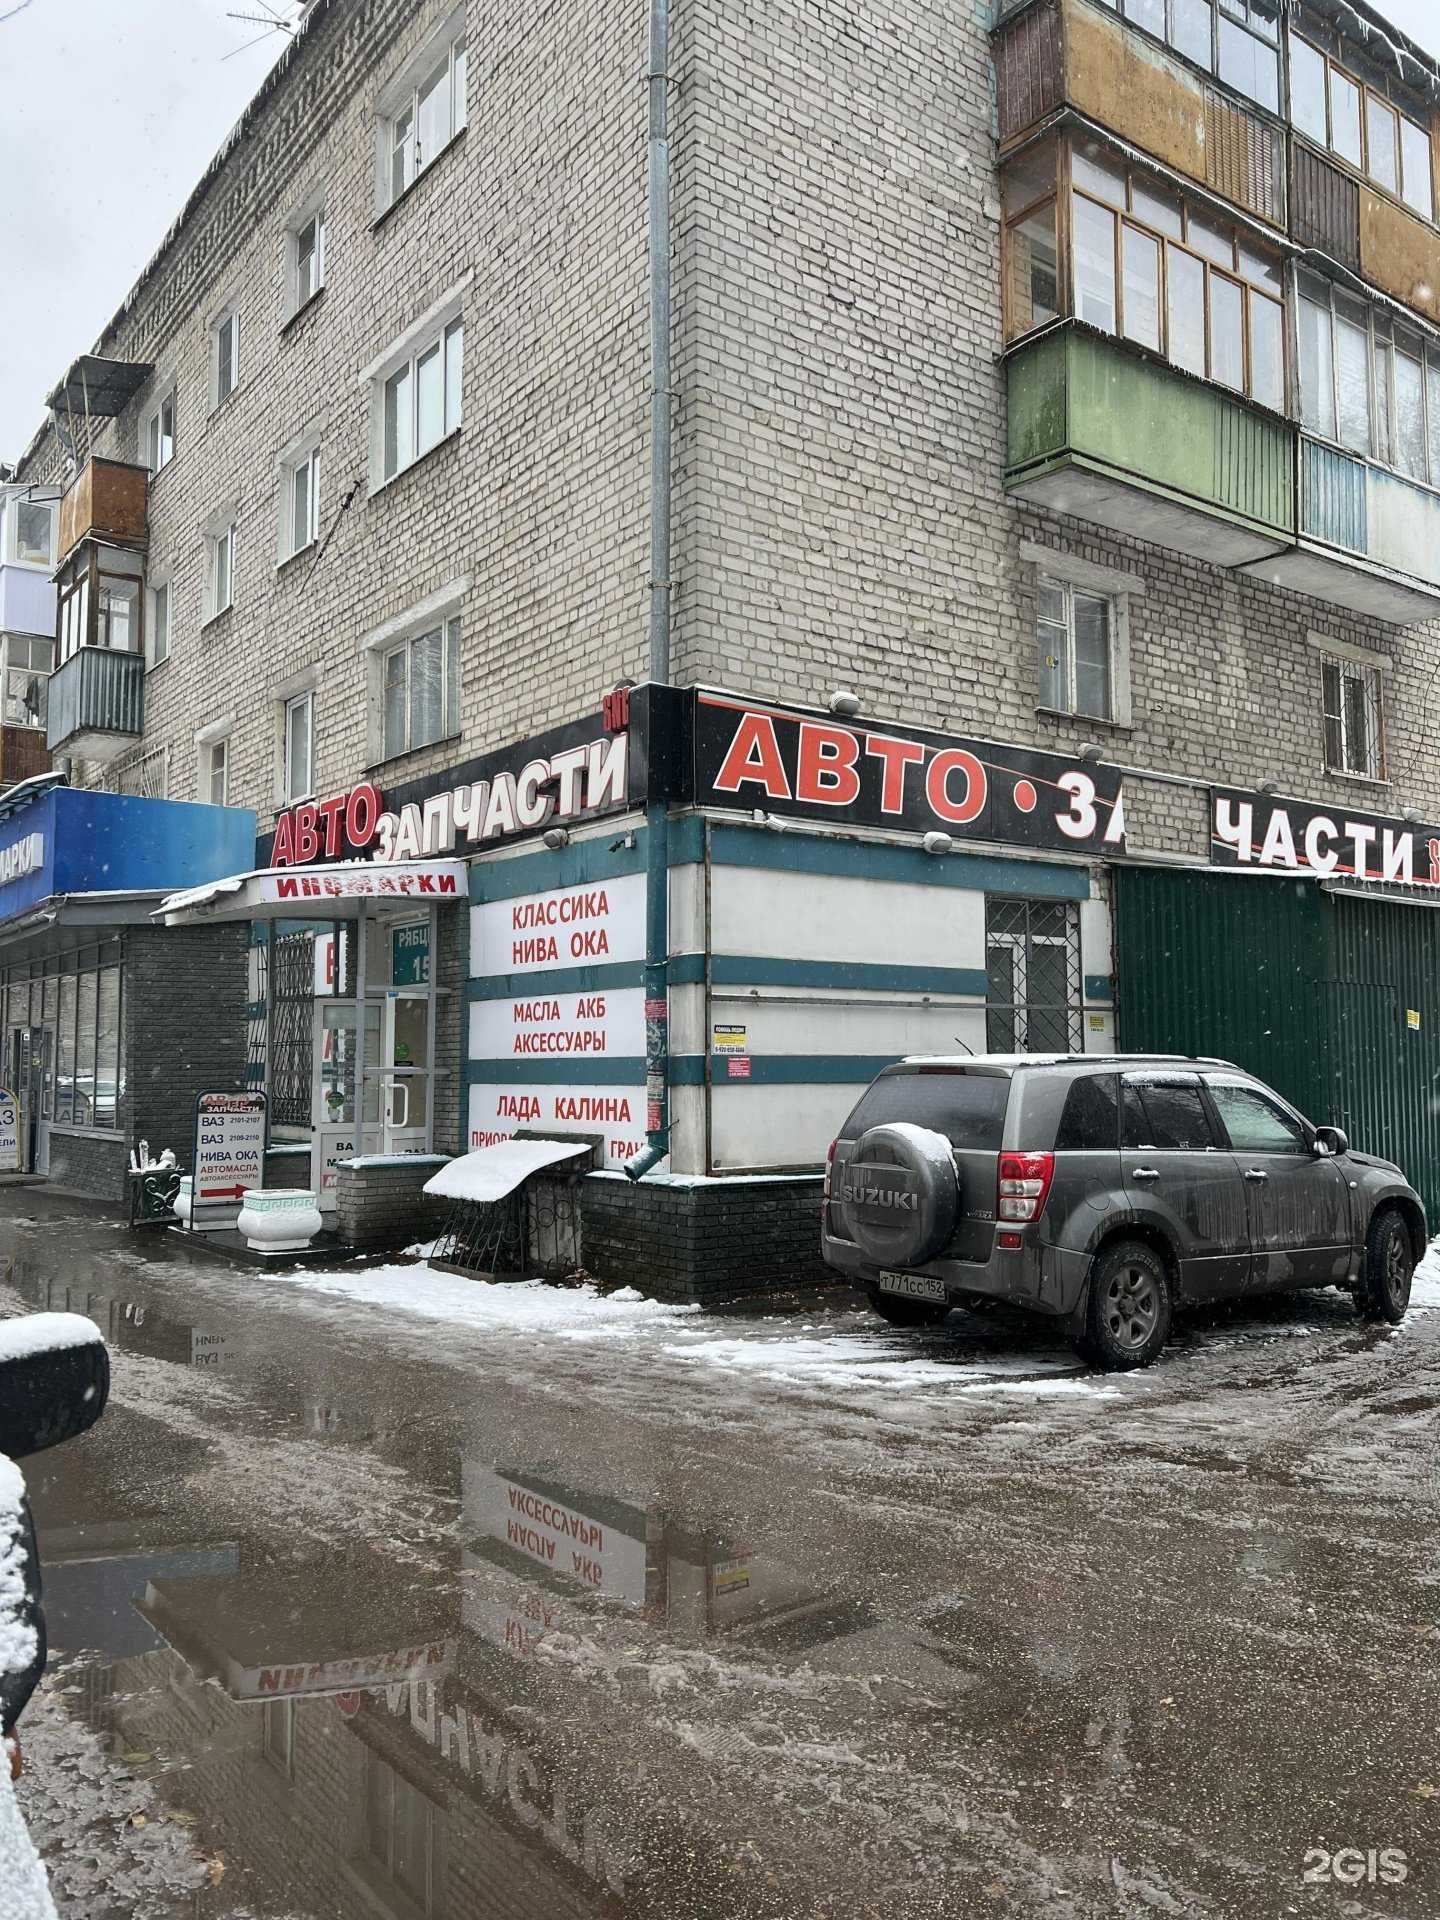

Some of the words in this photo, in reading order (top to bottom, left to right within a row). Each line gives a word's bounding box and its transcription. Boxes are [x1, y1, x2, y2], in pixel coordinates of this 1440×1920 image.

[712, 711, 988, 825] АВТО
[372, 731, 629, 862] ЗАПЧАСТИ
[270, 782, 384, 868] АВТО
[1215, 798, 1413, 883] ЧАСТИ
[512, 890, 609, 930] КЛАССИКА
[399, 926, 430, 948] РЯБЦ
[513, 936, 559, 965] НИВА
[570, 929, 609, 958] ОКА
[513, 1000, 561, 1023] МАСЛА
[576, 996, 606, 1019] АКБ
[513, 1030, 606, 1053] АКСЕССУАРЫ
[201, 1117, 225, 1127] ВАЗ
[496, 1095, 541, 1122] ЛАДА
[555, 1097, 631, 1122] КАЛИНА
[201, 1134, 224, 1144] ВАЗ
[200, 1151, 232, 1162] НИВА
[235, 1150, 258, 1160] ОКА
[200, 1163, 259, 1174] АВТОМАСЛА
[840, 1184, 919, 1211] SUZUKI
[925, 1279, 943, 1294] 152
